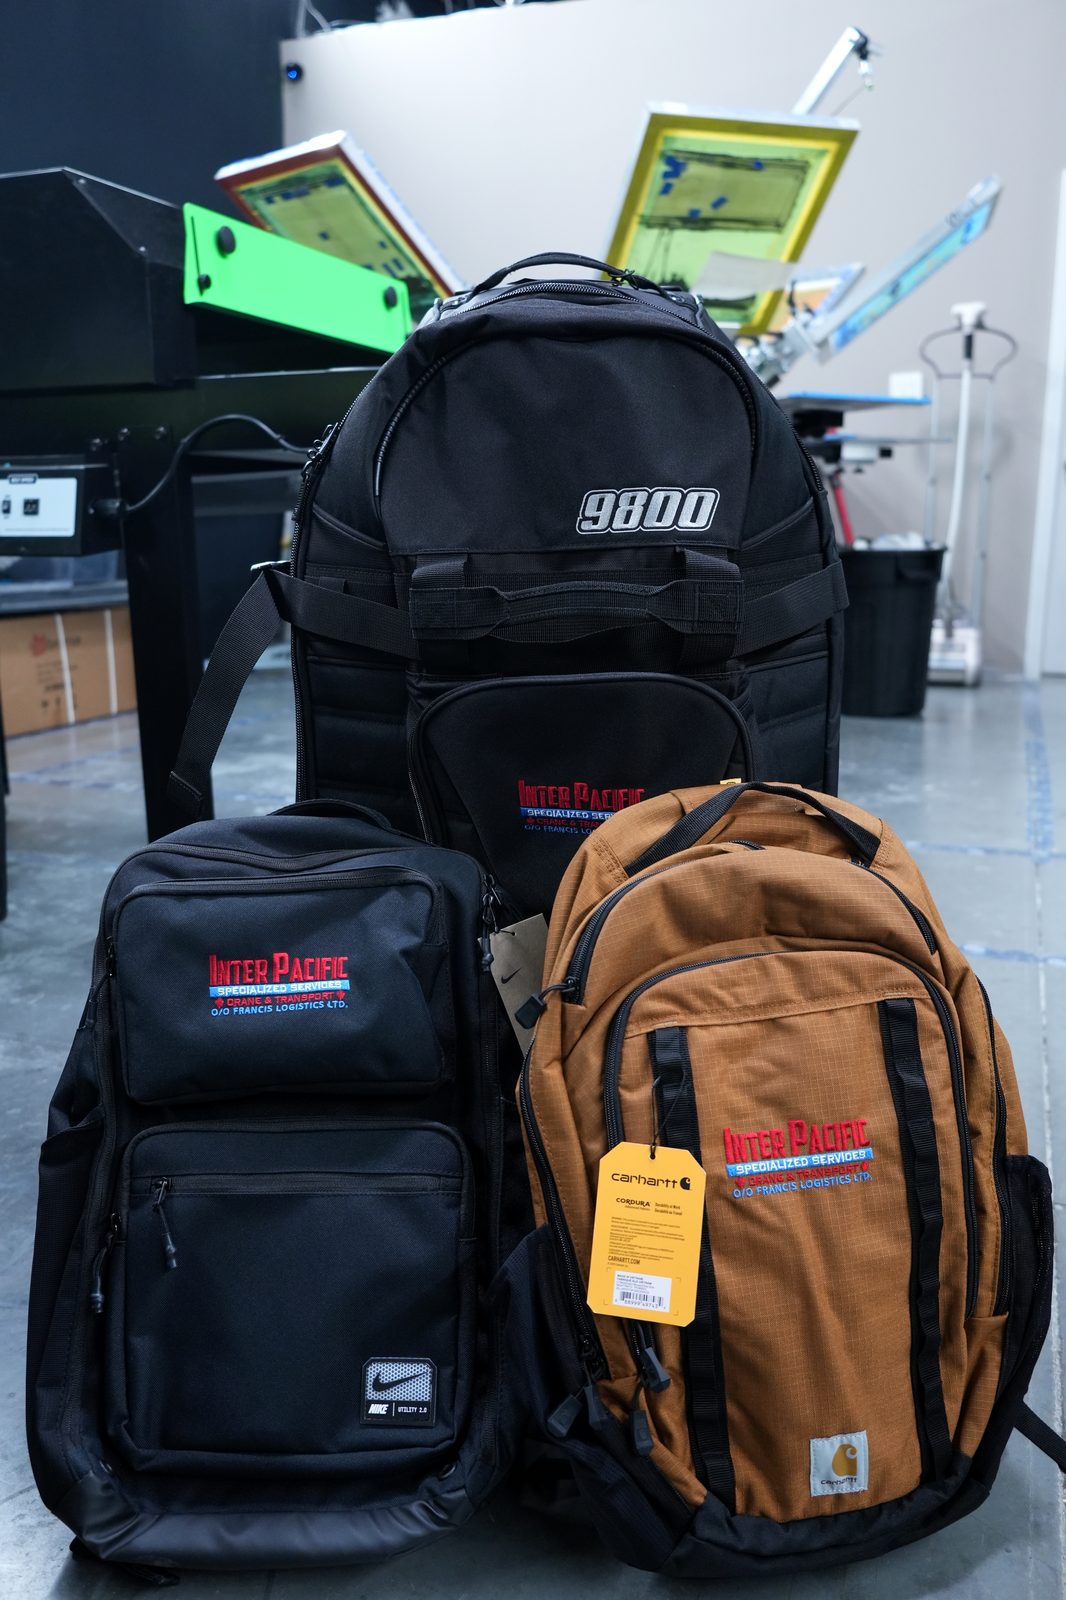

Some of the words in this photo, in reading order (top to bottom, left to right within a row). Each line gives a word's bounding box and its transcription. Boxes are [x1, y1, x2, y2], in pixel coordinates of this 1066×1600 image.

[577, 487, 720, 534] 9800
[518, 780, 571, 808] INTER
[527, 810, 589, 819] SPECIALIZED
[544, 826, 579, 834] FRANCIS
[209, 954, 268, 985] INTER
[272, 952, 348, 982] PACIFIC
[218, 984, 287, 996] SPECIALIZED
[291, 981, 342, 992] SERVICES
[227, 996, 261, 1007] CRANE
[264, 996, 272, 1004] &
[275, 991, 334, 1004] TRANSPORT
[211, 1008, 230, 1016] O/O
[233, 1005, 272, 1015] FRANCIS
[276, 1000, 324, 1012] LOGISTICS
[327, 1000, 348, 1009] LTD.
[723, 1127, 787, 1164] INTER
[788, 1119, 871, 1156] PACIFIC
[736, 1159, 808, 1174] SPECIALIZED
[812, 1150, 866, 1166] SERVICES
[611, 1172, 678, 1189] carhartt
[786, 1173, 796, 1182] &
[797, 1164, 860, 1180] TRANSPORT
[733, 1187, 753, 1199] O/O
[756, 1182, 797, 1195] FRANCIS
[800, 1174, 851, 1189] LOGISTICS
[853, 1171, 872, 1182] LTD.
[615, 1197, 651, 1208] CORDURA
[368, 1403, 389, 1415] NIKE
[820, 1476, 857, 1486] carhartt
